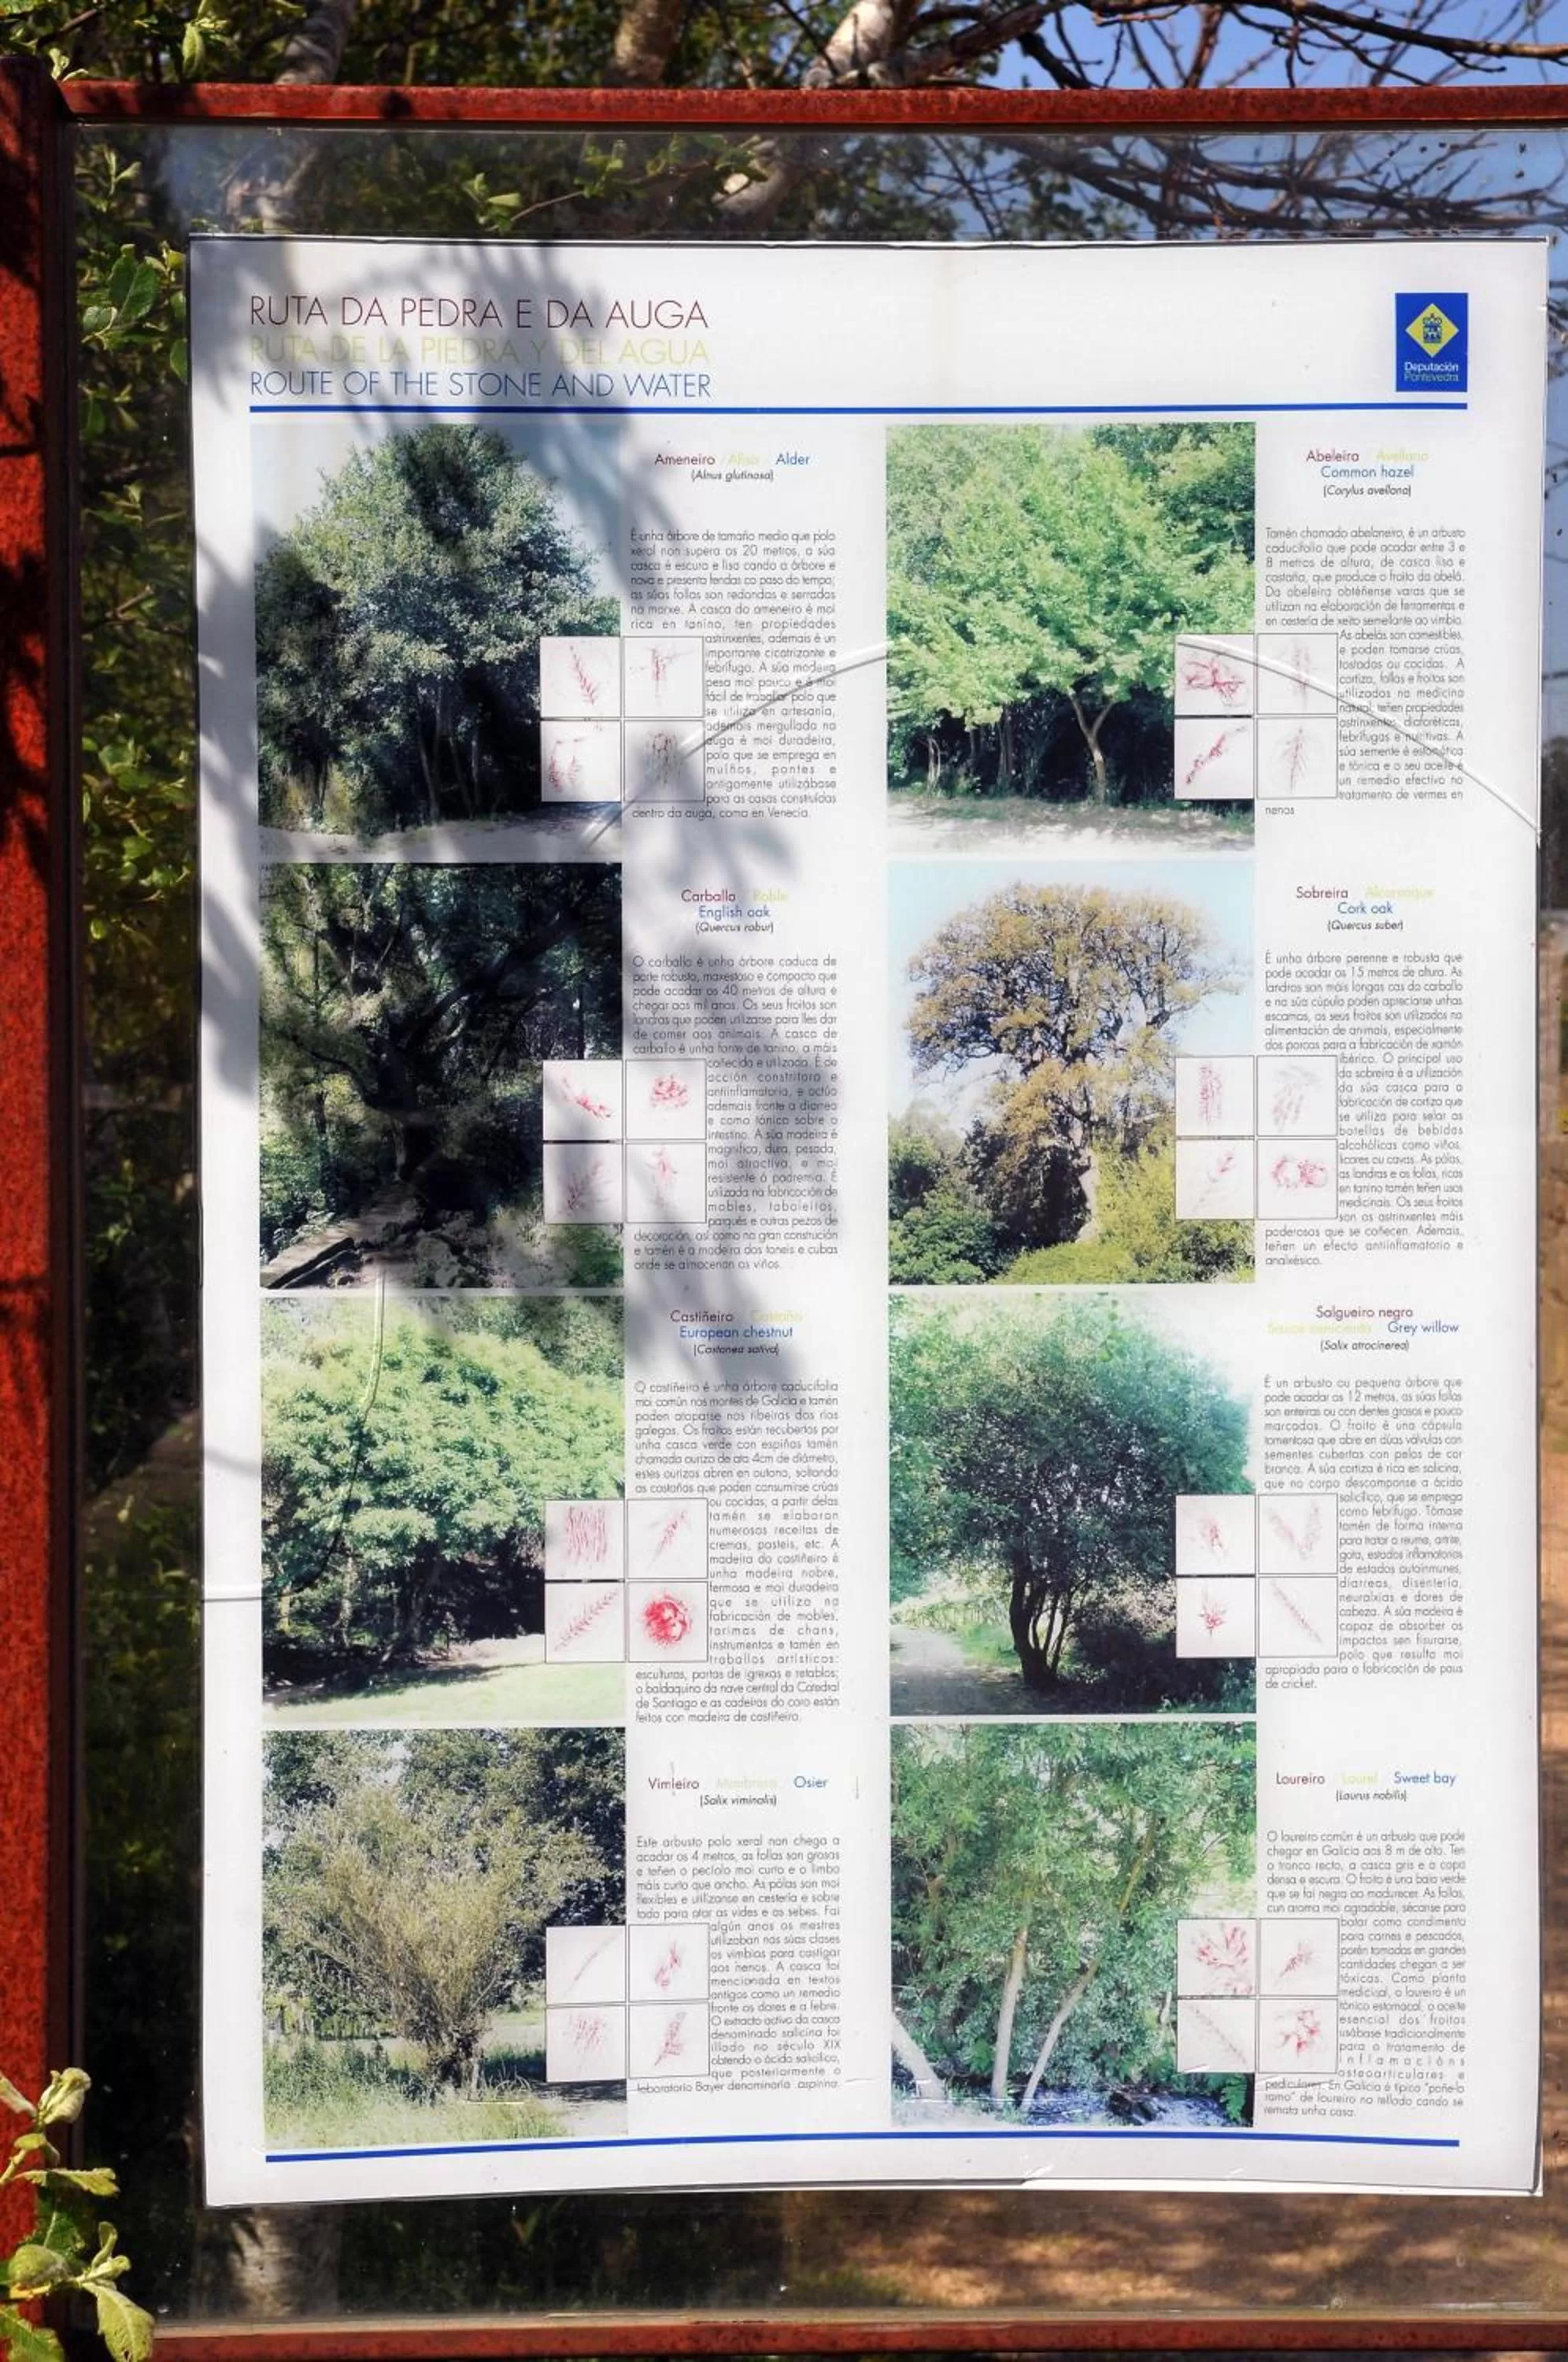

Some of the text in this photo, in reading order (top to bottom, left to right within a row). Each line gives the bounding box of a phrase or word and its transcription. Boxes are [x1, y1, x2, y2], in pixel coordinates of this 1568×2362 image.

[250, 295, 708, 329] RUTA DA PEDRA E DA AUGA
[251, 336, 708, 365] RUTA DE LA PIEDRA Y DEL AGUA
[1404, 361, 1459, 374] Deputación
[1404, 372, 1460, 382] Pontevedra
[251, 372, 712, 398] ROUTE OF THE STONE AND WATER
[654, 454, 716, 465] Ameneiro
[775, 453, 811, 465] Alder
[1306, 450, 1359, 462] Abeleira
[691, 470, 774, 483] (Alnus glutinosa)
[1320, 465, 1415, 478] Common hazel
[1323, 485, 1411, 498] (Corylus avellana)
[1278, 557, 1316, 568] metros
[1320, 555, 1335, 568] de
[1341, 555, 1374, 569] altura,
[1380, 555, 1396, 568] de
[1399, 559, 1430, 568] casca
[1436, 555, 1456, 568] lisa
[631, 617, 654, 628] rica
[685, 617, 726, 630] tanino,
[734, 617, 754, 628] ten
[761, 616, 837, 633] propiedades
[1352, 642, 1385, 658] poden
[1389, 643, 1430, 654] tomarse
[1433, 642, 1463, 656] crúas,
[707, 761, 756, 776] muíños,
[772, 763, 817, 778] pontes
[631, 805, 810, 822] dentro da auga, como en Venecia.
[681, 890, 736, 901] Carballo
[1296, 887, 1348, 899] Sobreira
[698, 905, 771, 920] English oak
[1337, 902, 1393, 914] Cork oak
[695, 922, 774, 934] (Quercus robur)
[1328, 920, 1403, 932] (Quercus suber)
[1276, 950, 1302, 963] unha
[1307, 950, 1341, 963] árbore
[1346, 954, 1389, 967] perenne
[1403, 950, 1440, 963] robusta
[1444, 953, 1463, 966] que
[707, 1069, 748, 1082] acción
[757, 1071, 821, 1082] constritora
[1338, 1123, 1463, 1135] botellas de bebidas
[708, 1199, 837, 1213] mobles, taboleiros,
[634, 1257, 781, 1269] onde se almacenan os viños.
[670, 1310, 734, 1323] Castiñeiro
[1316, 1305, 1413, 1321] Salgueiro negro
[679, 1326, 793, 1340] European chestnut
[1388, 1321, 1418, 1335] Grey
[1422, 1320, 1459, 1333] willow
[693, 1343, 779, 1357] (Castanea sativa)
[1320, 1340, 1410, 1352] (Salix atrocinerea)
[1276, 1379, 1289, 1388] un
[1293, 1375, 1333, 1388] arbusto
[1336, 1379, 1350, 1388] ou
[1355, 1379, 1401, 1391] pequena
[1405, 1375, 1440, 1387] árbore
[1443, 1379, 1463, 1391] que
[708, 1509, 838, 1521] tamén se elaboran
[708, 1522, 840, 1535] numerosas receitas de
[708, 1566, 838, 1580] unha madeira nobre,
[1339, 1618, 1463, 1635] capaz de absorber os
[793, 1775, 828, 1789] Osier
[1276, 1772, 1325, 1785] Loureiro
[1394, 1772, 1430, 1784] Sweet
[1433, 1772, 1457, 1786] bay
[700, 1794, 777, 1807] (Salix viminalis)
[1336, 1790, 1407, 1801] (Laurus nobilis)
[636, 1834, 658, 1847] Este
[663, 1834, 703, 1847] arbusto
[708, 1834, 732, 1851] polo
[736, 1834, 763, 1846] xeral
[767, 1838, 788, 1846] non
[793, 1834, 830, 1850] chega
[1267, 1843, 1304, 1860] chegar
[1305, 1847, 1318, 1856] en
[1322, 1842, 1360, 1855] Galicia
[1363, 1846, 1383, 1855] aos
[1407, 1842, 1423, 1855] de
[1424, 1842, 1446, 1855] alto.
[1451, 1842, 1466, 1855] Ten
[711, 1918, 840, 1934] algún anos os mestres
